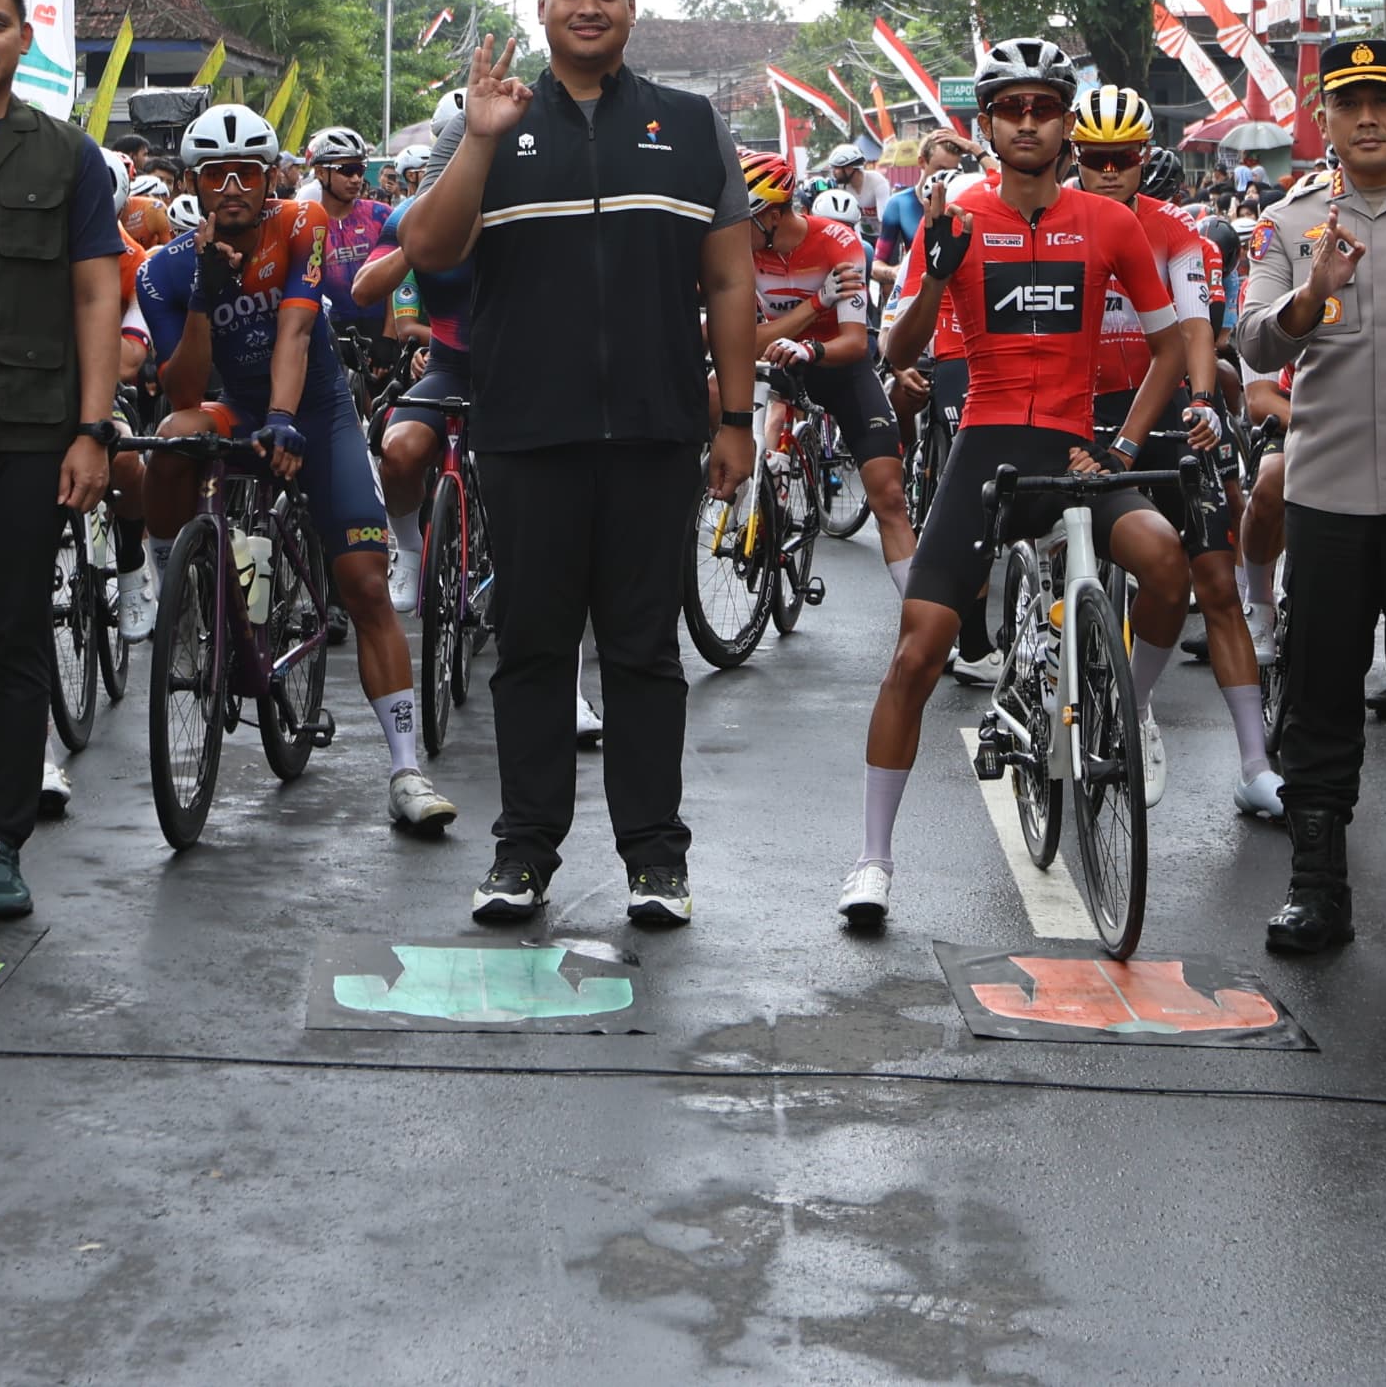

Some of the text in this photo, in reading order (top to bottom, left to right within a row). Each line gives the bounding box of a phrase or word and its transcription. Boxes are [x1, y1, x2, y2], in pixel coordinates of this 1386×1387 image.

[1157, 202, 1197, 232] ANTA
[821, 223, 856, 249] ANTA
[994, 285, 1075, 311] ASC
[1105, 296, 1123, 312] TA
